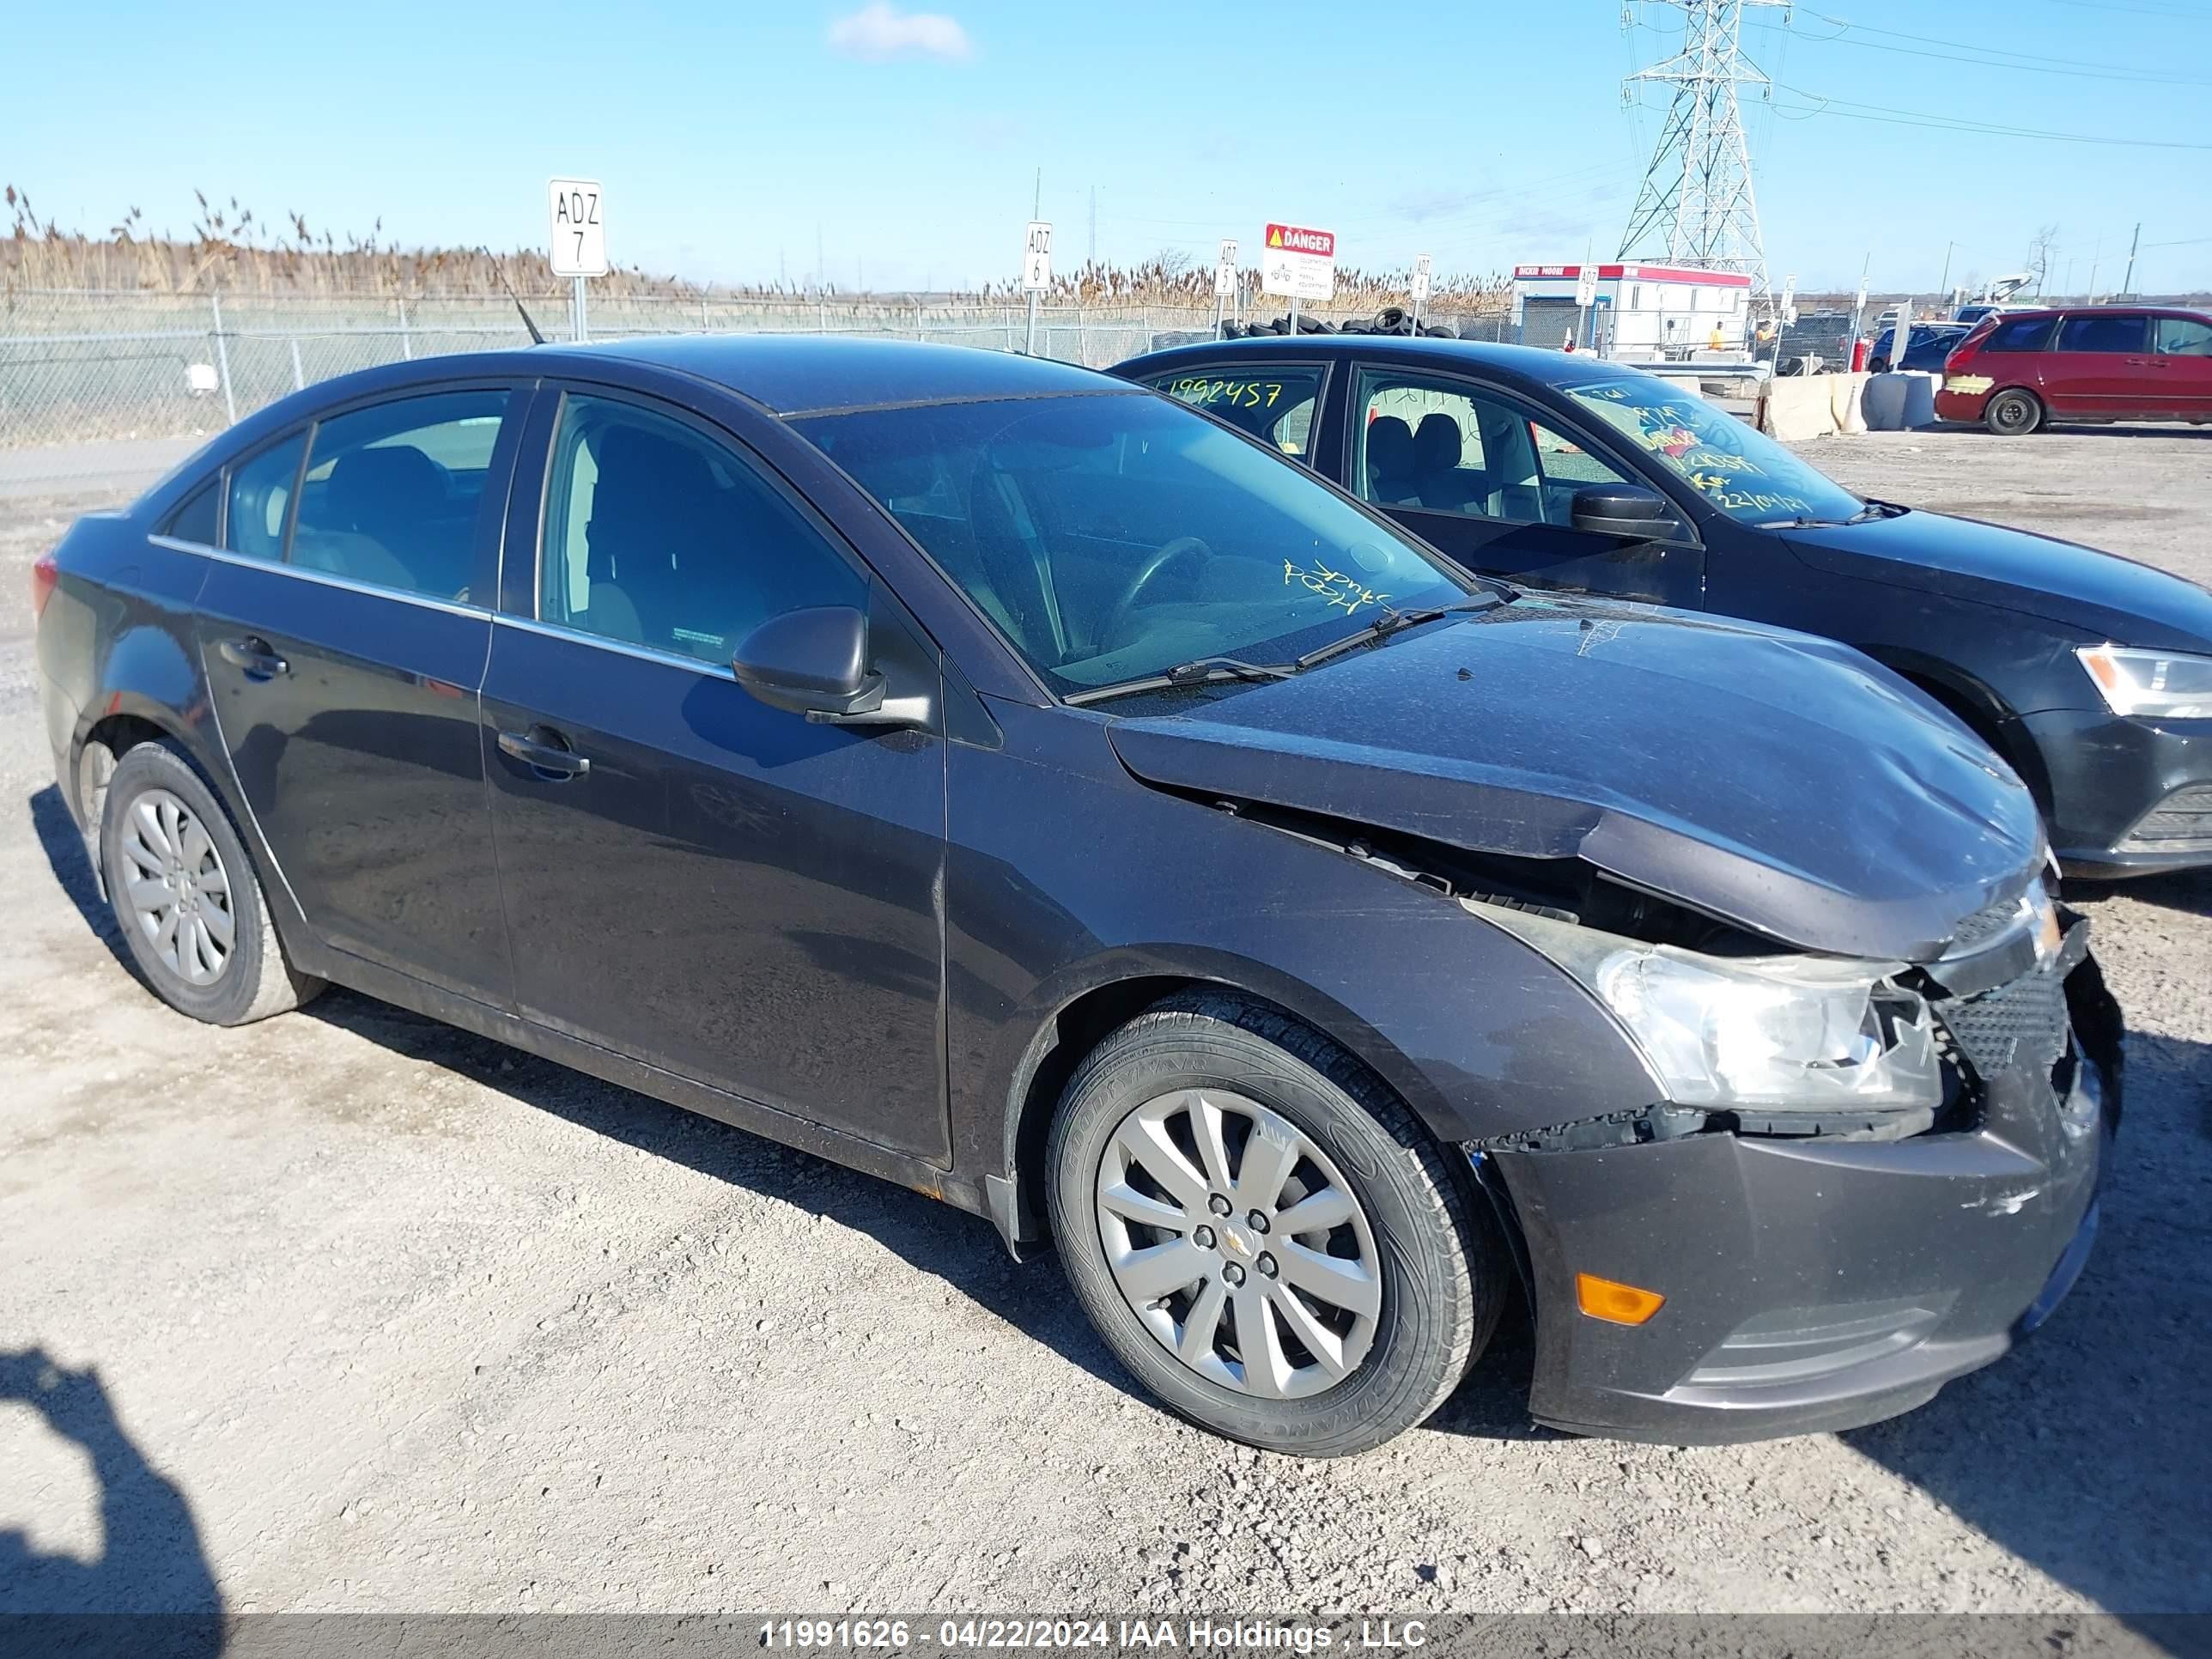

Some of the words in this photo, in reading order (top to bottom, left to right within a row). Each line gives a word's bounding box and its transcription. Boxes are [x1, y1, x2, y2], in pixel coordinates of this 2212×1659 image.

[557, 191, 599, 225] ADZ
[573, 231, 584, 262] 7
[1028, 229, 1050, 254] ADZ
[1283, 229, 1332, 253] DANGER
[1220, 246, 1237, 265] ADZ
[1033, 258, 1040, 282] 6
[1223, 268, 1229, 289] 5
